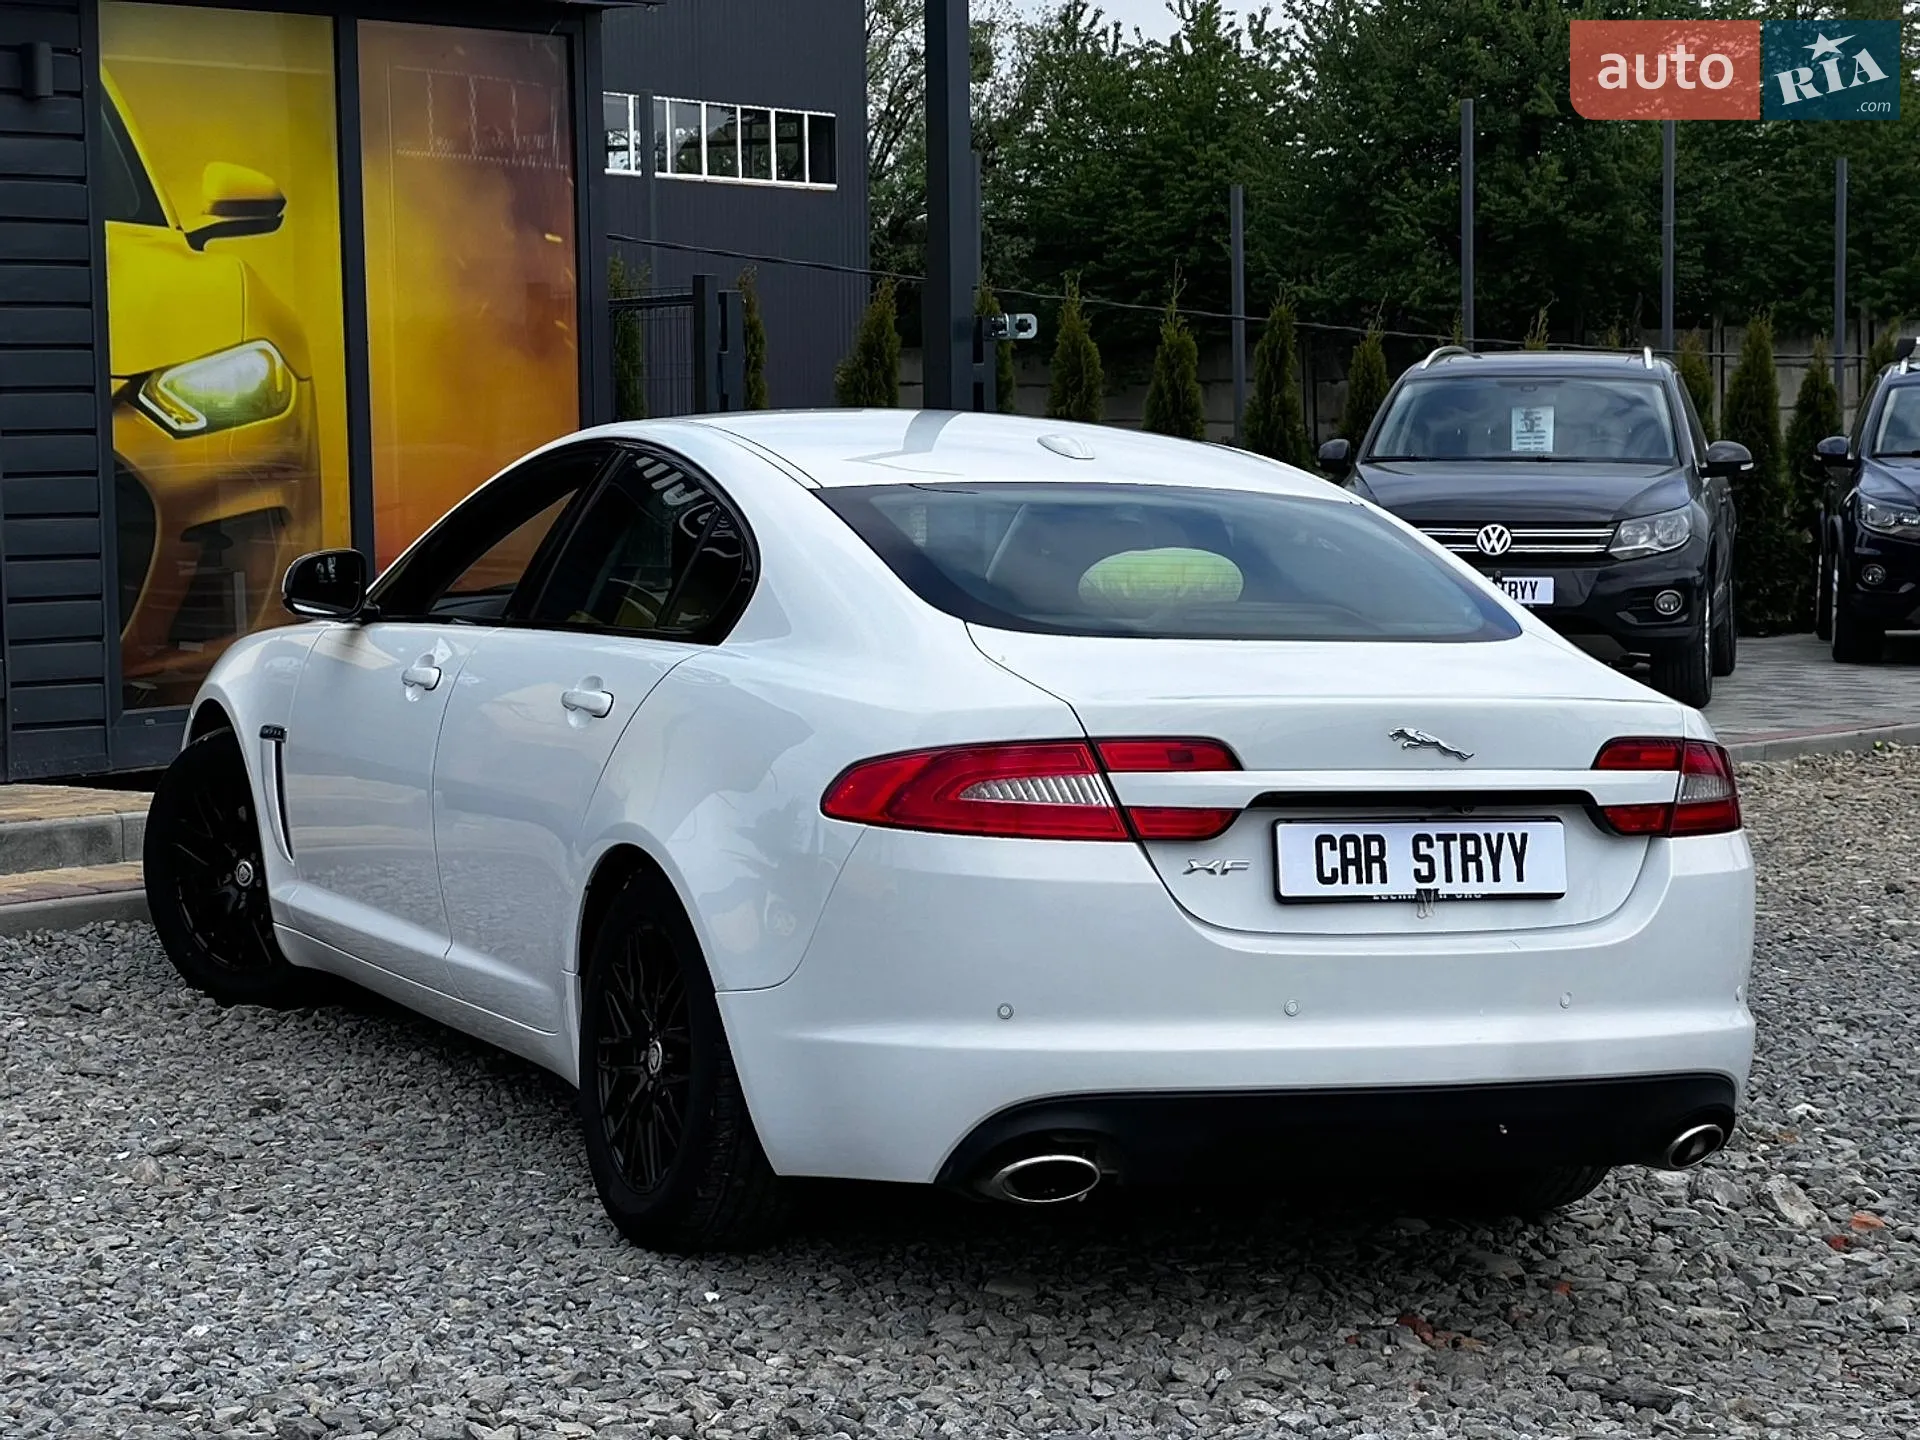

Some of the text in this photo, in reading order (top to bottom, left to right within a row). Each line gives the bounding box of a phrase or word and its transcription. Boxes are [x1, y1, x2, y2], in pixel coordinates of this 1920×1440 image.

[1182, 859, 1251, 875] XF
[1314, 832, 1529, 885] CAR STRYY
